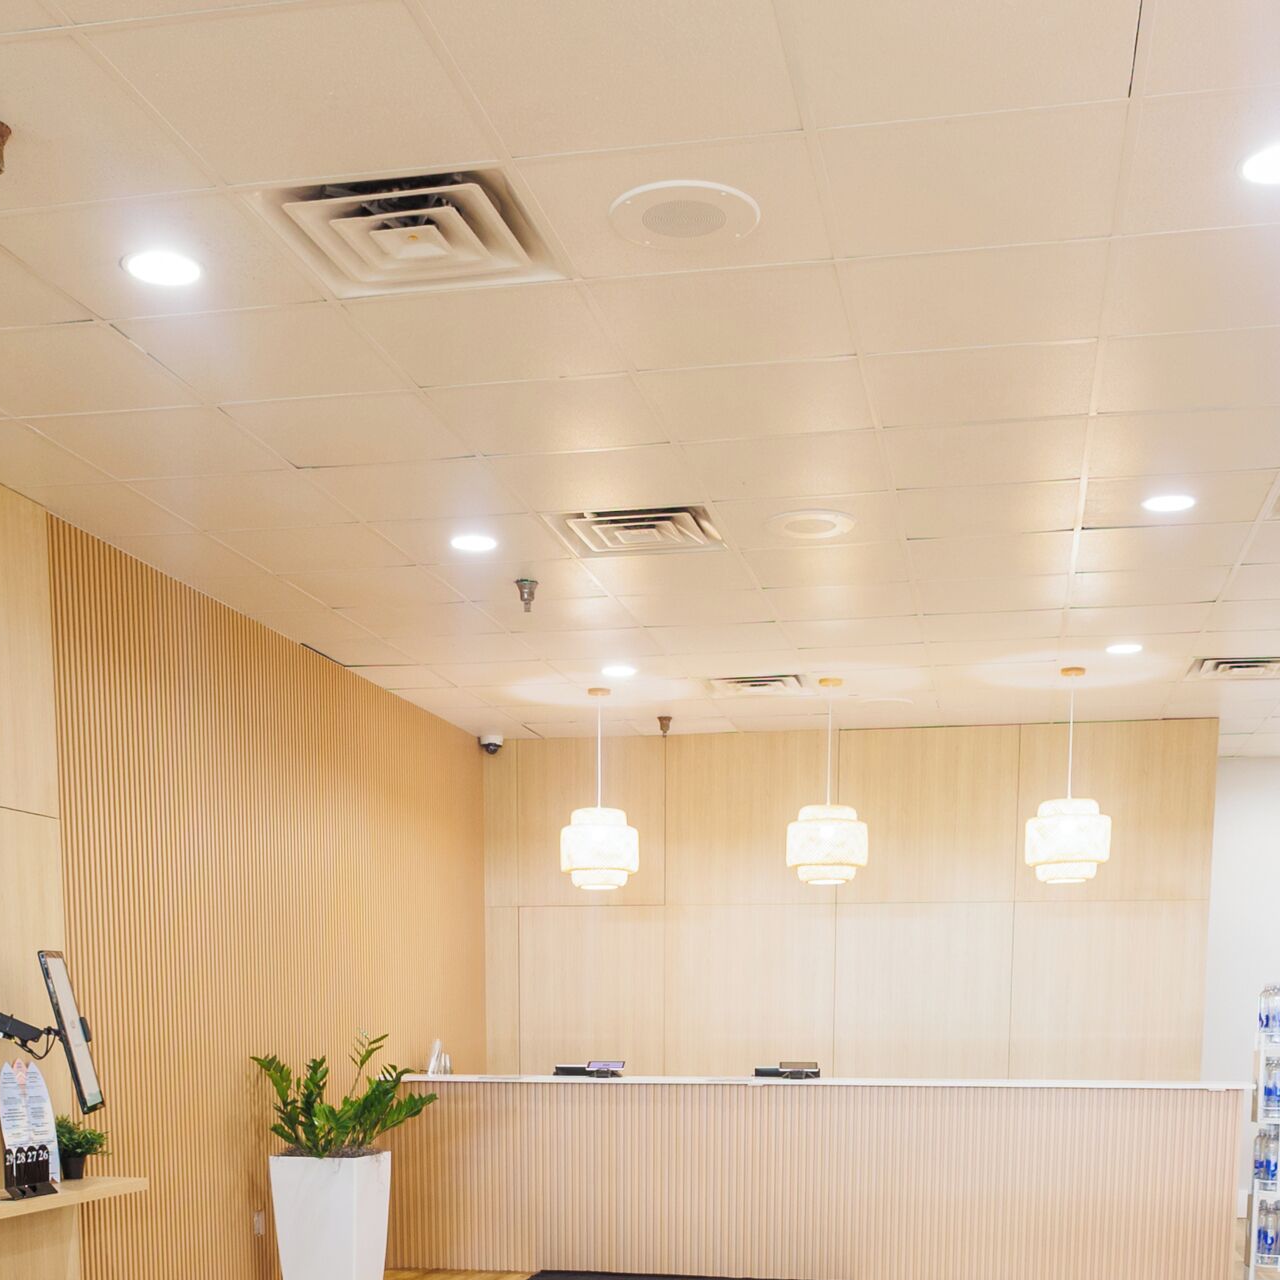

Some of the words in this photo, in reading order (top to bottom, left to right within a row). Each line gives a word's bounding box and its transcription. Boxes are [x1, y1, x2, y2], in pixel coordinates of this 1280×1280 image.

[16, 1152, 26, 1164] 28
[27, 1151, 37, 1163] 27
[38, 1149, 49, 1160] 26
